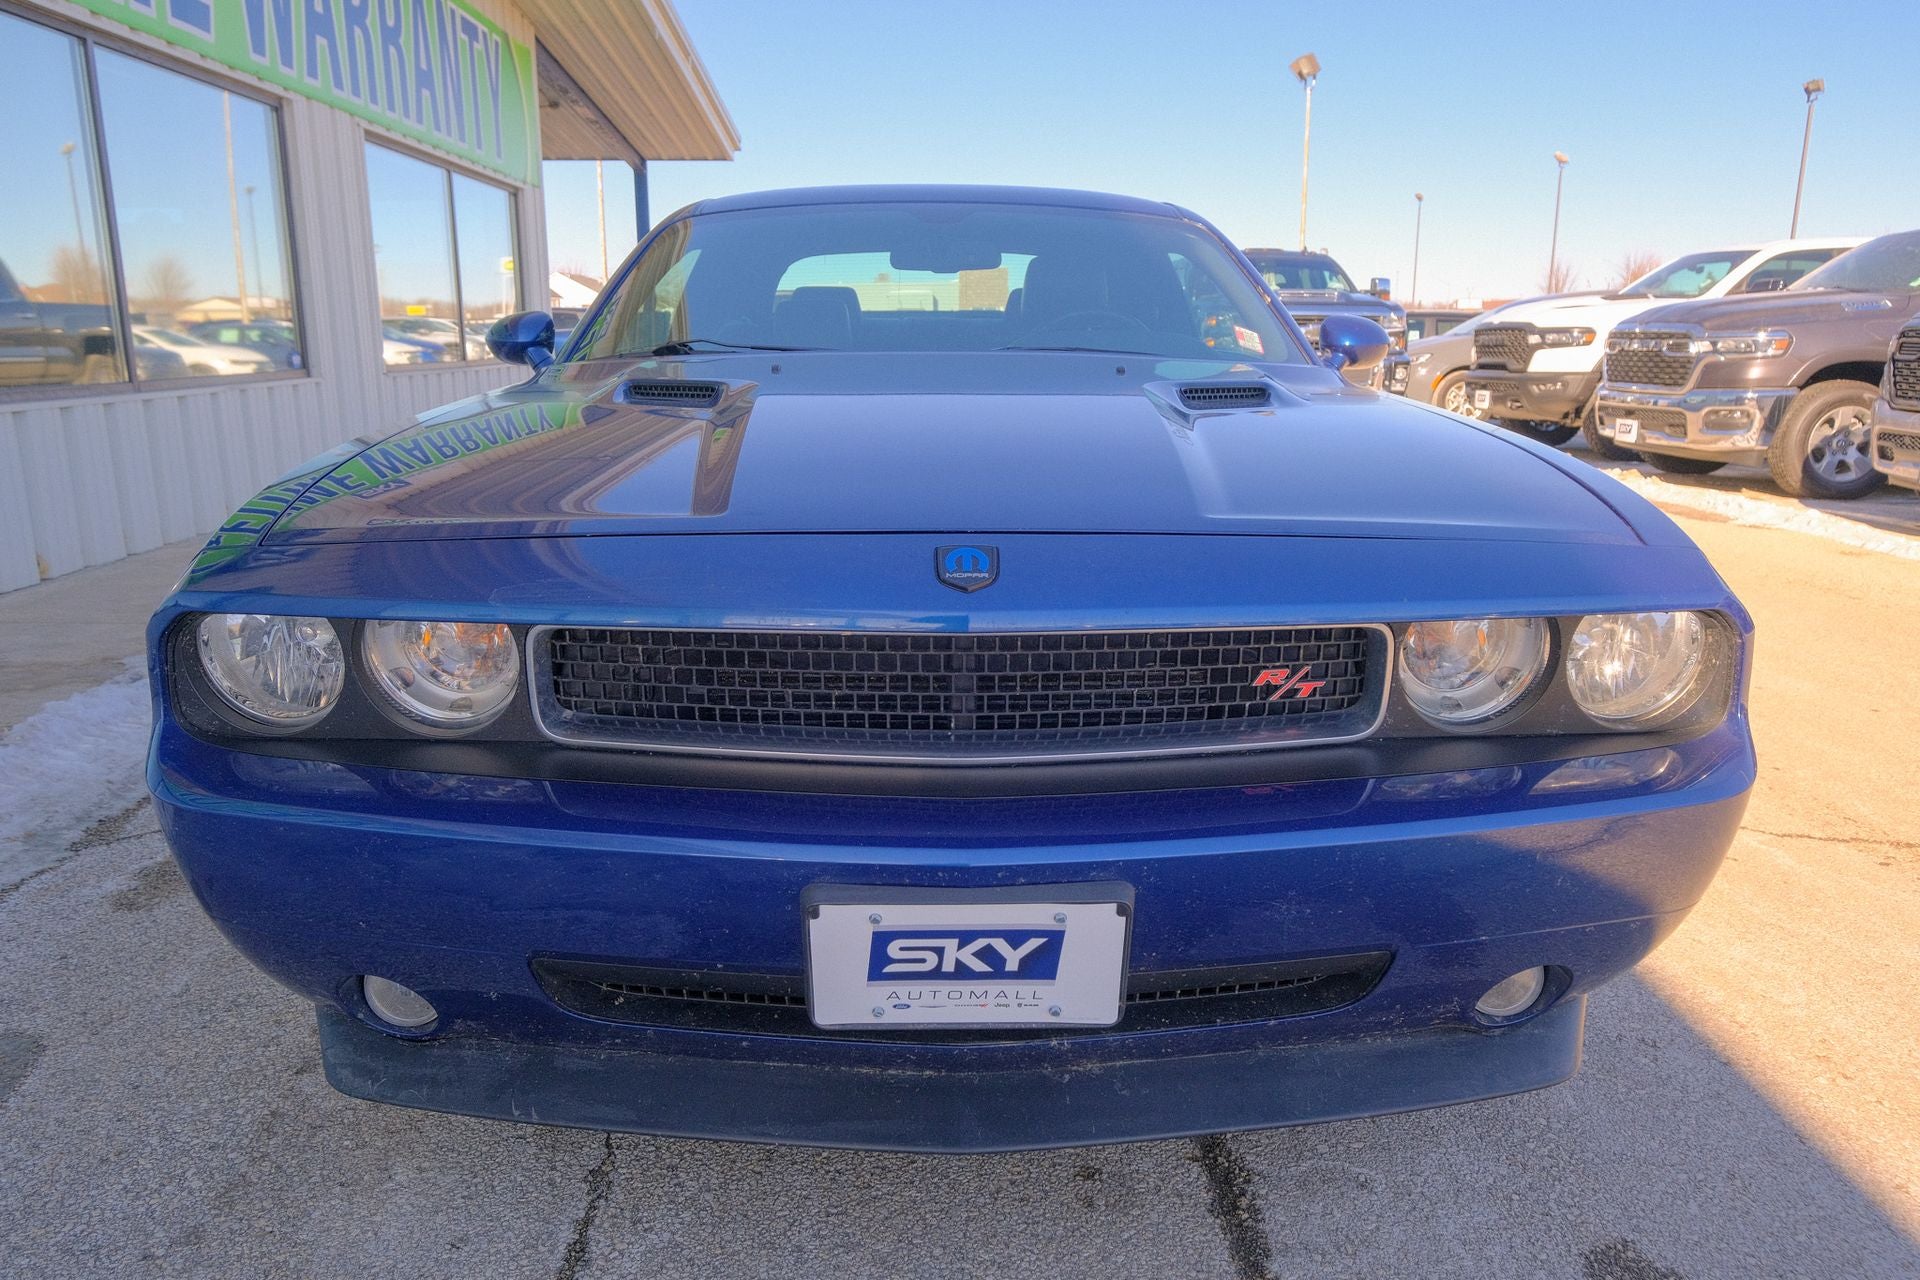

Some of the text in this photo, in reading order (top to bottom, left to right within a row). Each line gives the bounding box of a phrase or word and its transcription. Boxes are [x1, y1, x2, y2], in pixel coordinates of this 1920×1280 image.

[1252, 665, 1326, 701] R/T
[882, 937, 1049, 973] SKY
[886, 989, 1043, 1000] AUTOMALL
